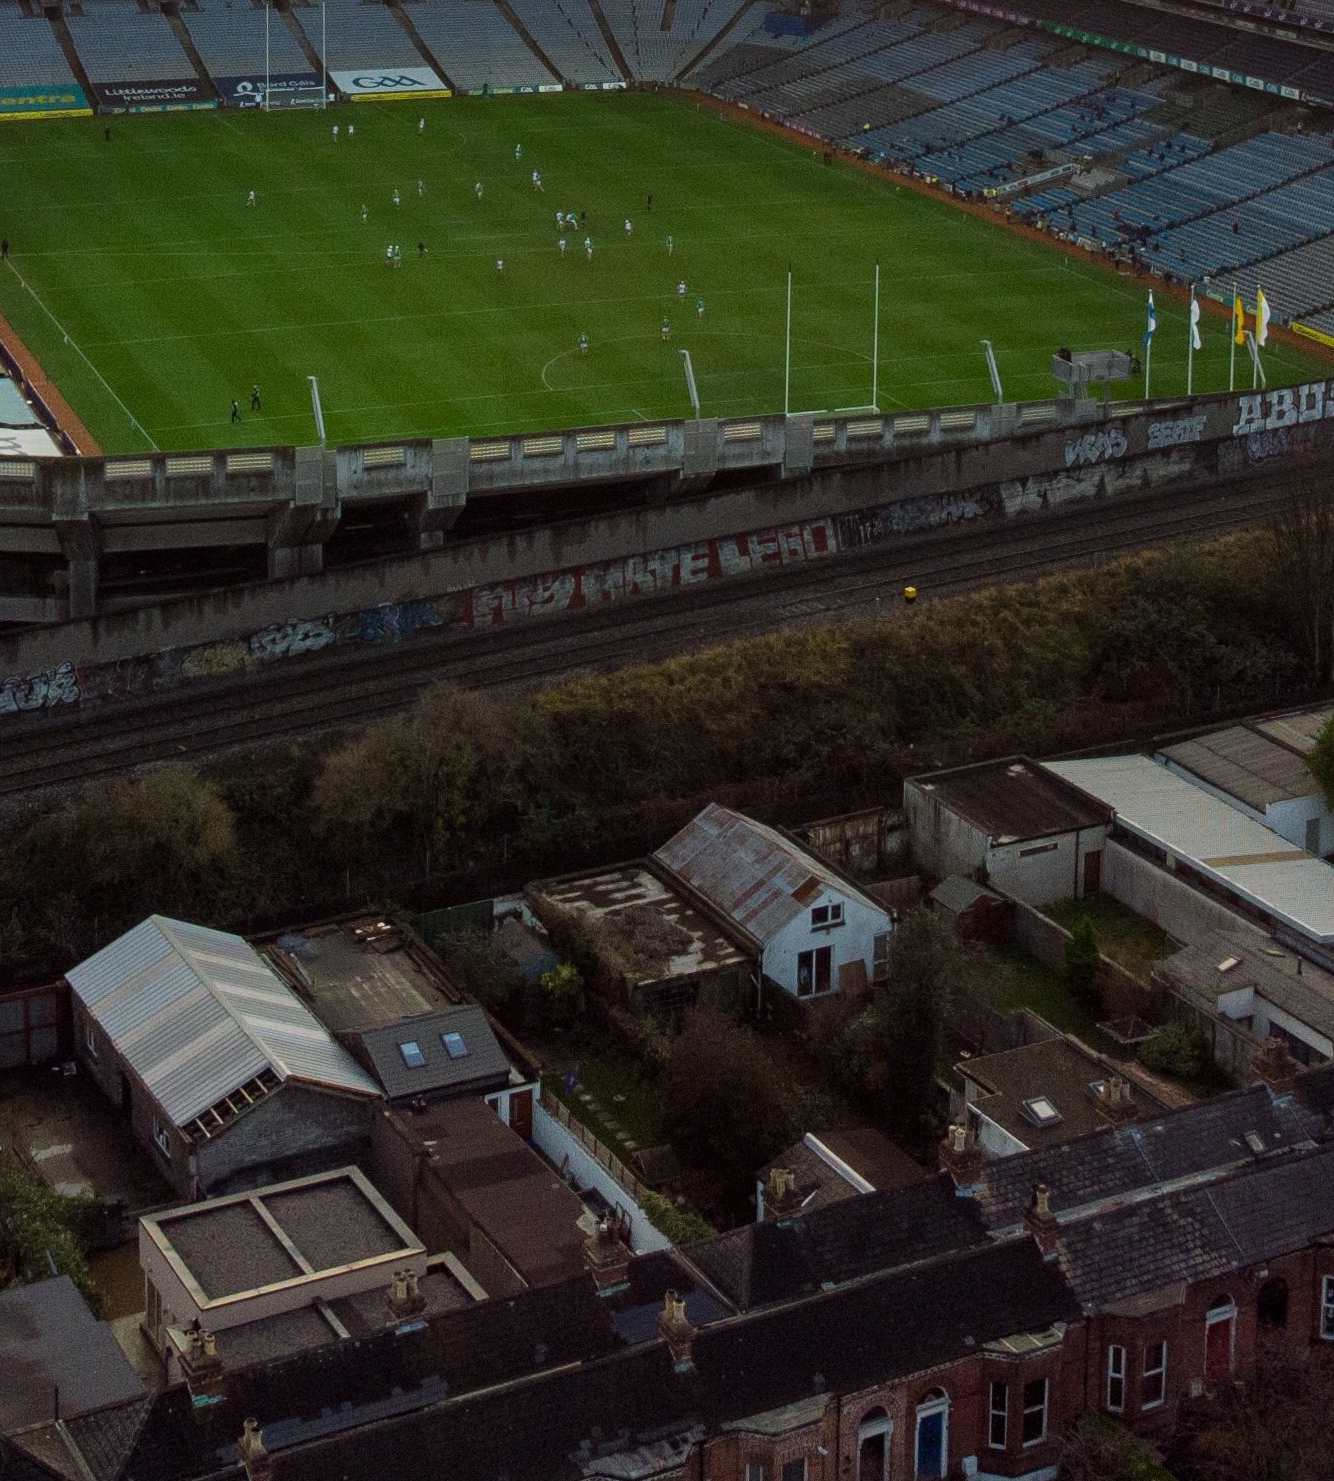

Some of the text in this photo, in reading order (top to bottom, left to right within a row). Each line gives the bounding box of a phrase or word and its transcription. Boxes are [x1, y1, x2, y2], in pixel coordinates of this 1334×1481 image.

[105, 85, 197, 97] Littlewoods
[123, 92, 186, 102] Ireland.ie
[718, 519, 838, 579] LEGO
